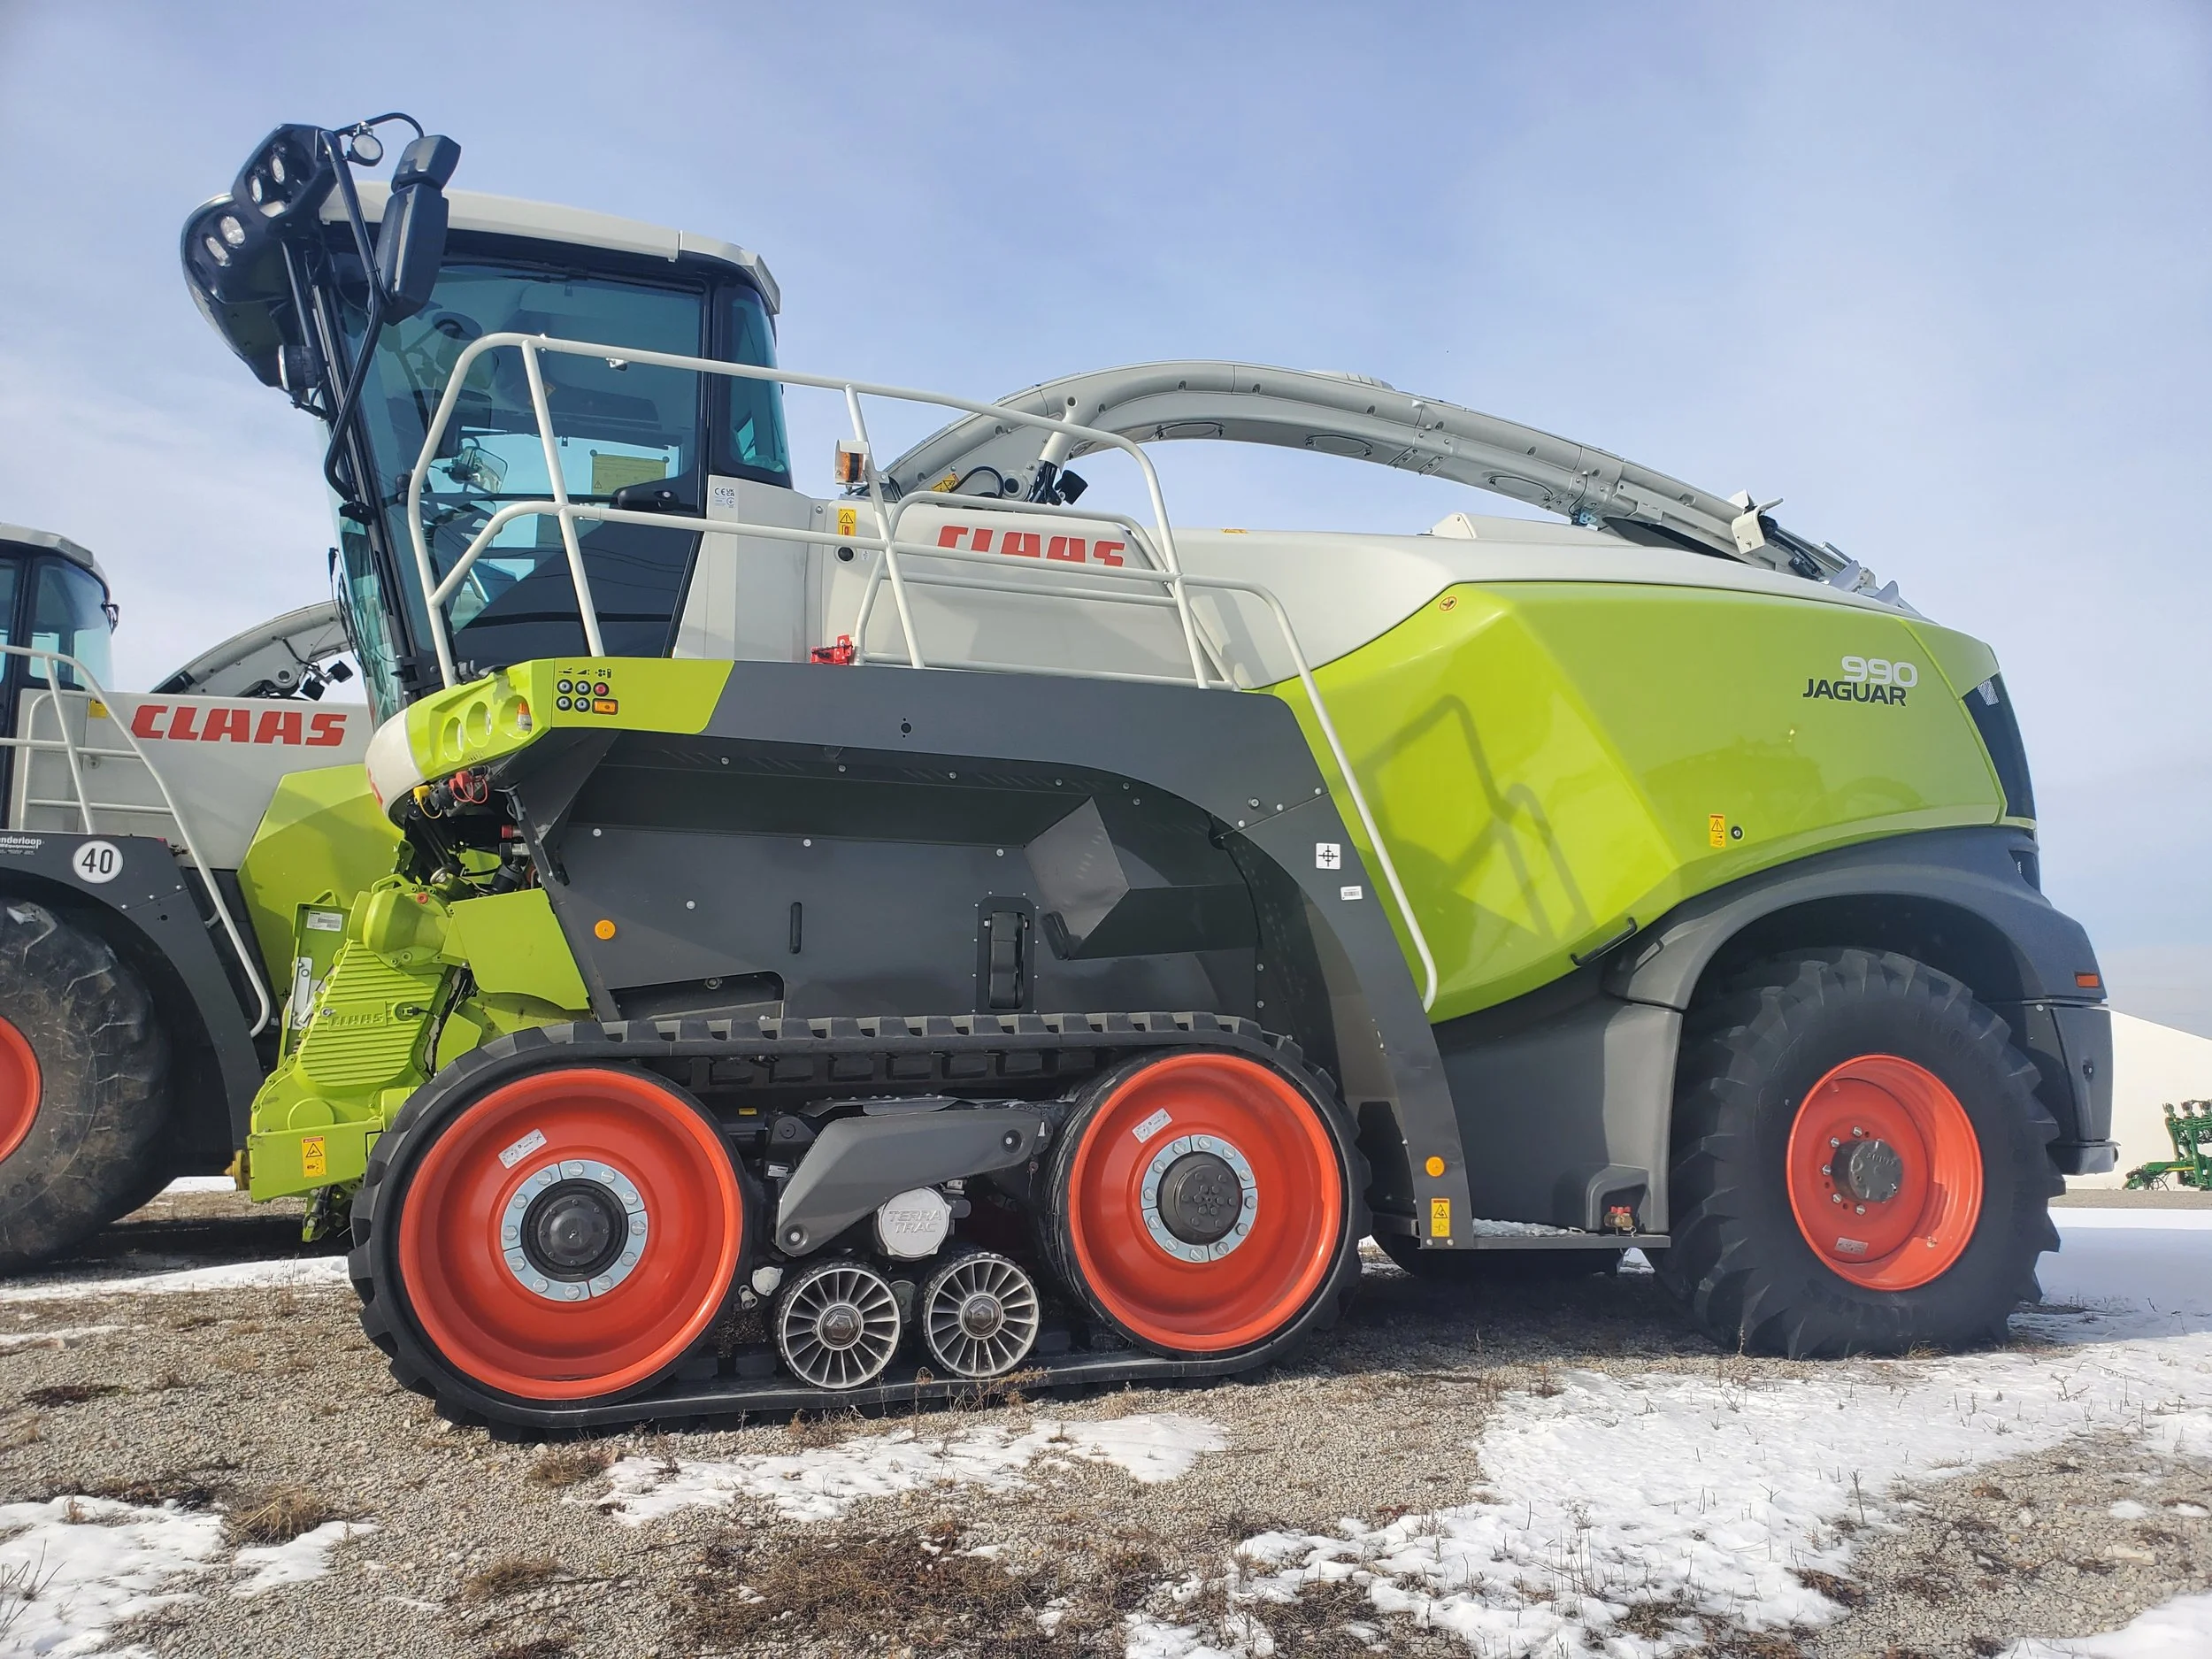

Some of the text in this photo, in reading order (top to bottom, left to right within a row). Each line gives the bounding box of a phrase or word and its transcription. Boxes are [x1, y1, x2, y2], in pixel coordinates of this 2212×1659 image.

[1841, 656, 1918, 687] 990
[1802, 679, 1907, 707] JAGUAR
[130, 704, 347, 747] CLAAS
[0, 835, 42, 849] nderloop
[81, 848, 114, 874] 40
[888, 1210, 942, 1223] TERRA
[895, 1222, 938, 1233] TRAC
